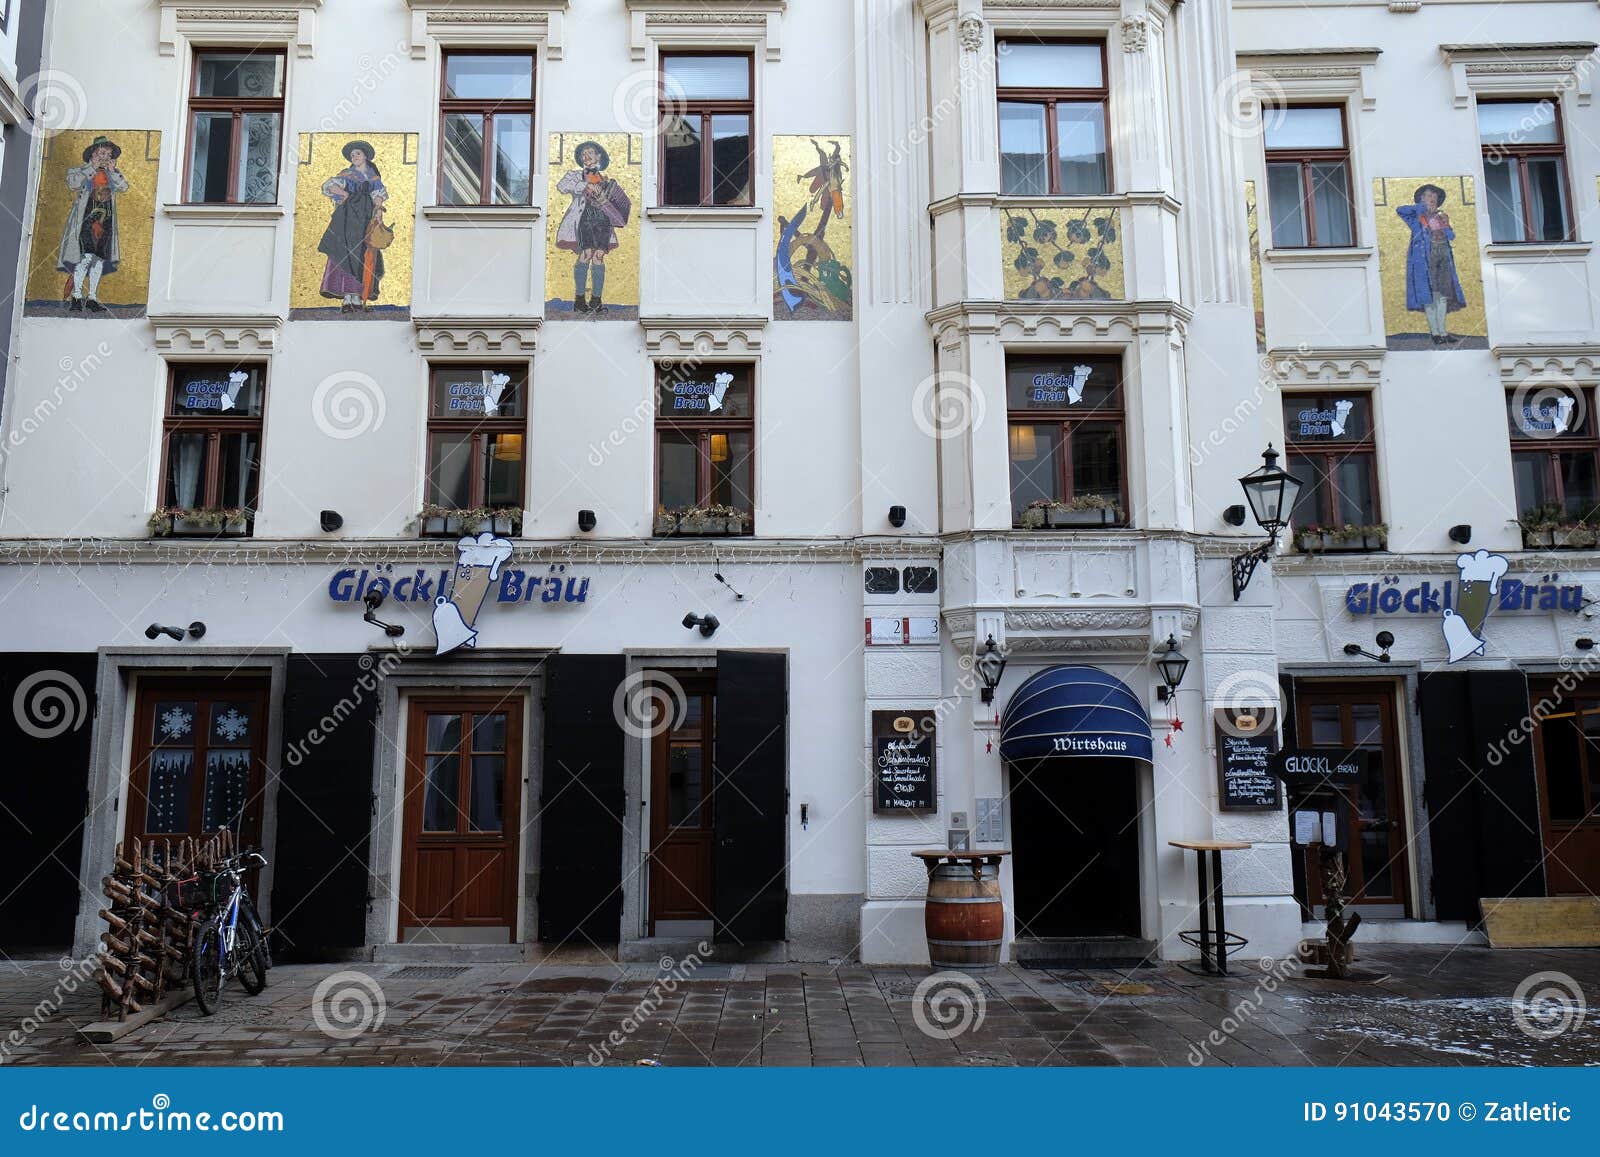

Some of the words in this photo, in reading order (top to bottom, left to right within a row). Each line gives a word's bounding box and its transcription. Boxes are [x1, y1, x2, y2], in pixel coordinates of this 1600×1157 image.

[1033, 372, 1072, 387] Glöckl
[186, 380, 229, 395] Glöckl
[449, 381, 492, 396] Glöckl
[673, 381, 714, 395] Glöckl
[1033, 387, 1066, 401] Bräu
[186, 395, 220, 409] Bräu
[449, 396, 481, 410] Bräu
[674, 395, 707, 409] Bräu
[1301, 422, 1330, 435] Bräu
[328, 563, 450, 603] Glöckl
[498, 564, 590, 604] Bräu
[1346, 575, 1453, 616] Glöckl
[1500, 572, 1583, 611] Bräu
[894, 620, 900, 633] 2
[931, 620, 938, 634] 3
[1053, 736, 1127, 752] Wirtshaus
[1285, 755, 1332, 773] GLÖCKL
[1337, 763, 1359, 774] BRÄU
